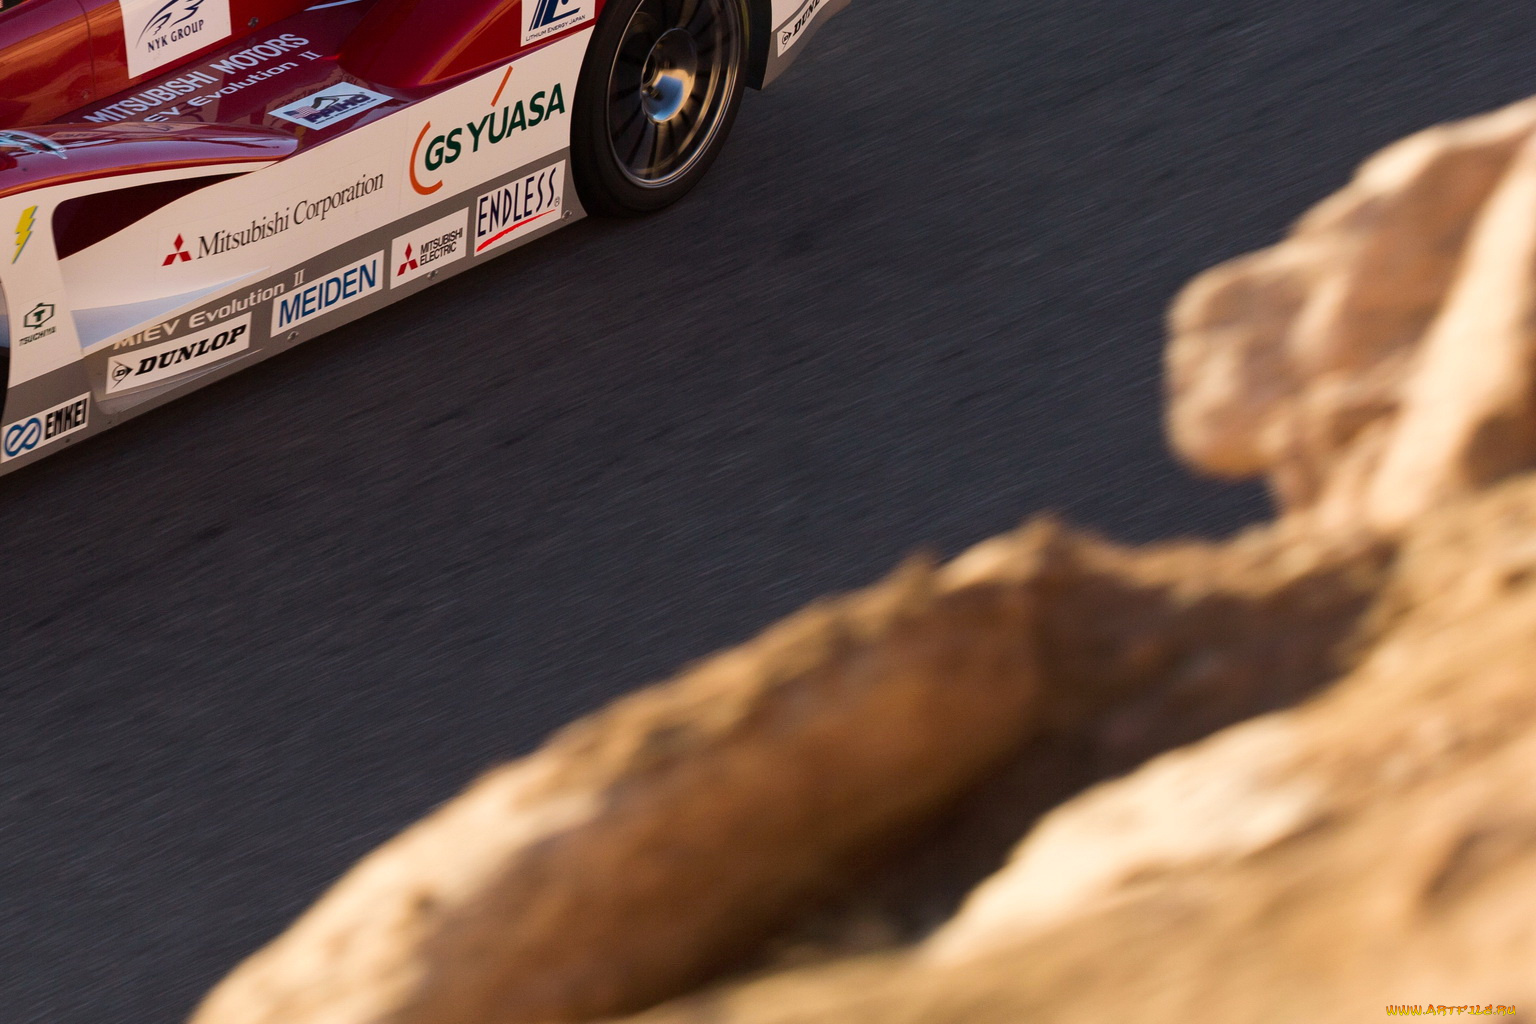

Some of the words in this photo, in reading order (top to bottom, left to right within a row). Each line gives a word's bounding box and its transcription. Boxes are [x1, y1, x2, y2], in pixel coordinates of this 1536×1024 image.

[147, 35, 168, 53] NYK
[170, 19, 205, 43] GROUP
[83, 70, 219, 123] MITSUBISHI
[210, 33, 310, 75] MOTORS
[187, 61, 299, 107] Evolution
[425, 127, 463, 171] GS
[466, 82, 566, 153] YUASA
[196, 207, 290, 260] Mitsubishi
[293, 173, 384, 226] Corporation
[476, 167, 558, 238] ENDLESS
[419, 242, 457, 266] ELECTRIC
[420, 227, 464, 254] MITSUBISHI
[189, 282, 285, 330] Evolution
[278, 259, 377, 328] MEIDEN
[135, 324, 248, 376] DUNLOP
